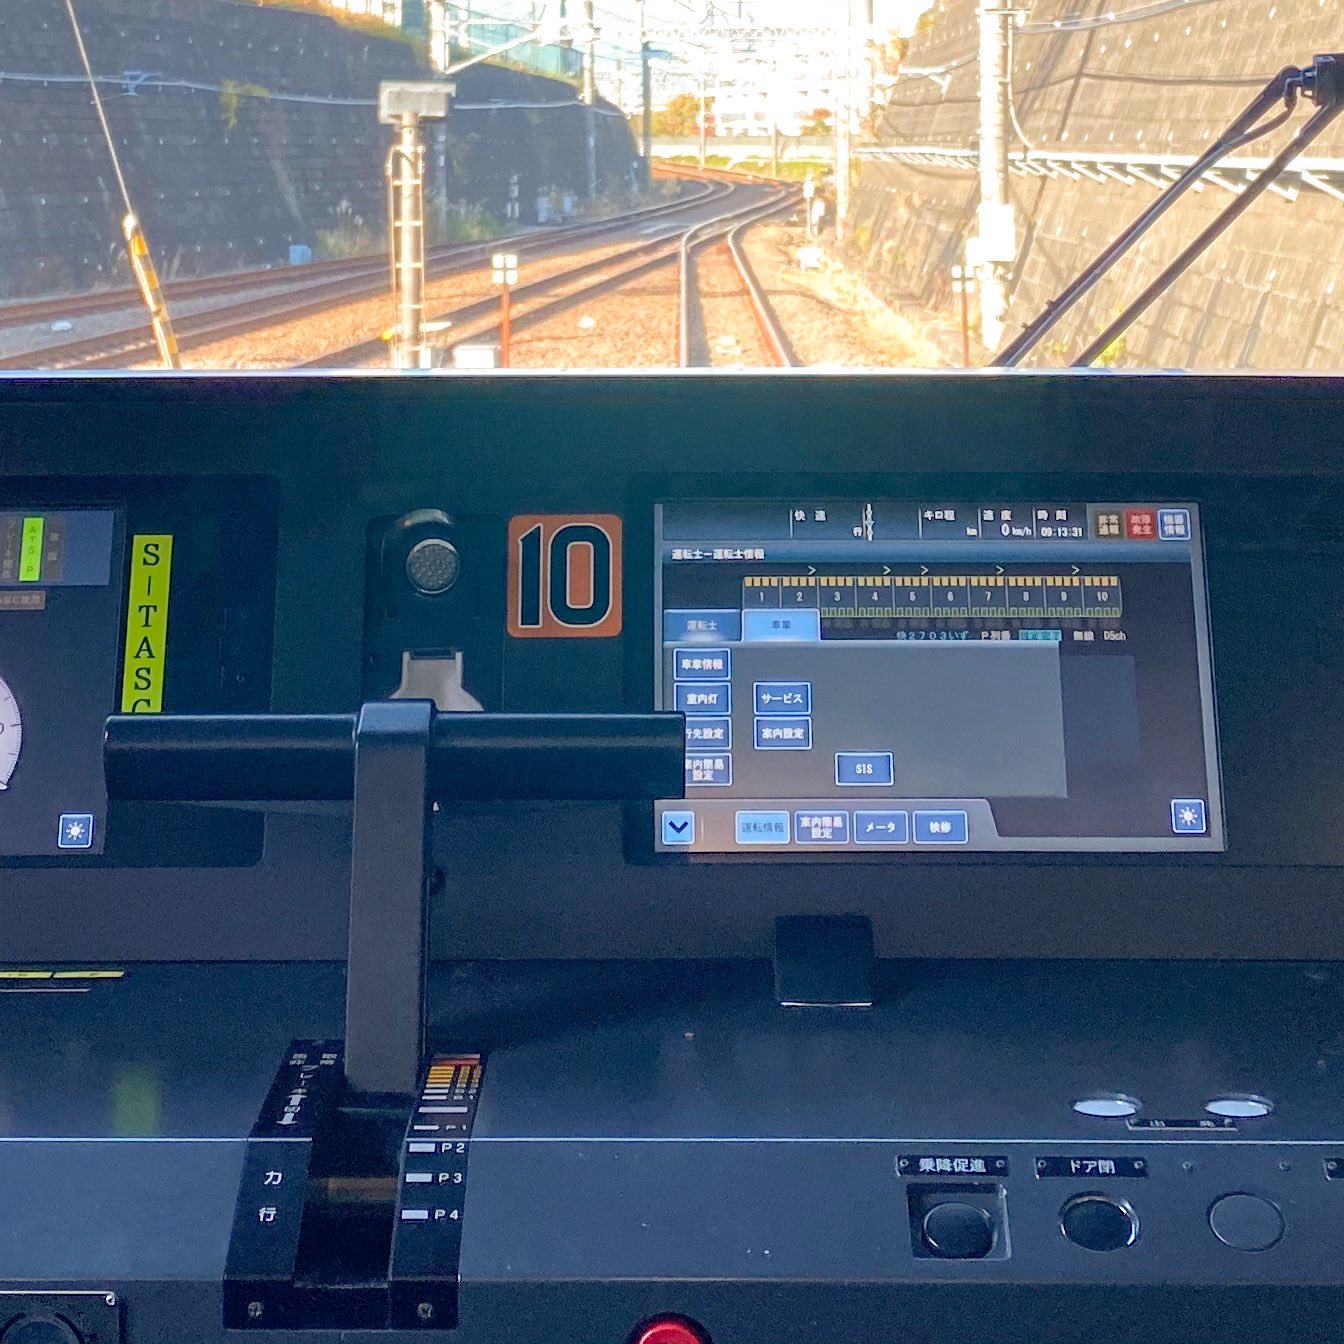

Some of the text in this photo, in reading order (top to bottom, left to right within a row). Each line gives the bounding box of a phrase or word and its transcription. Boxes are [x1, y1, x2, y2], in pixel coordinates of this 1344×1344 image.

[1041, 527, 1083, 537] 09:13:31
[518, 522, 613, 628] 10
[797, 592, 1108, 602] 2 3 4 10
[687, 621, 717, 631] 運転士
[682, 659, 722, 671] 車掌情報
[687, 694, 718, 705] 室内灯
[761, 694, 803, 704] サービス
[761, 728, 804, 740] 案内設定
[856, 764, 872, 774] SIS
[692, 771, 714, 781] 設定
[742, 822, 784, 833] 運転情報
[800, 817, 842, 828] 案内簡易
[865, 822, 896, 833] メータ
[811, 828, 832, 839] 設定
[442, 1143, 465, 1153] P2
[919, 1159, 987, 1173] 乗降促進
[1069, 1160, 1116, 1174] ドア閉
[439, 1173, 462, 1183] P3
[259, 1171, 282, 1222] 力行
[435, 1210, 458, 1220] P4
